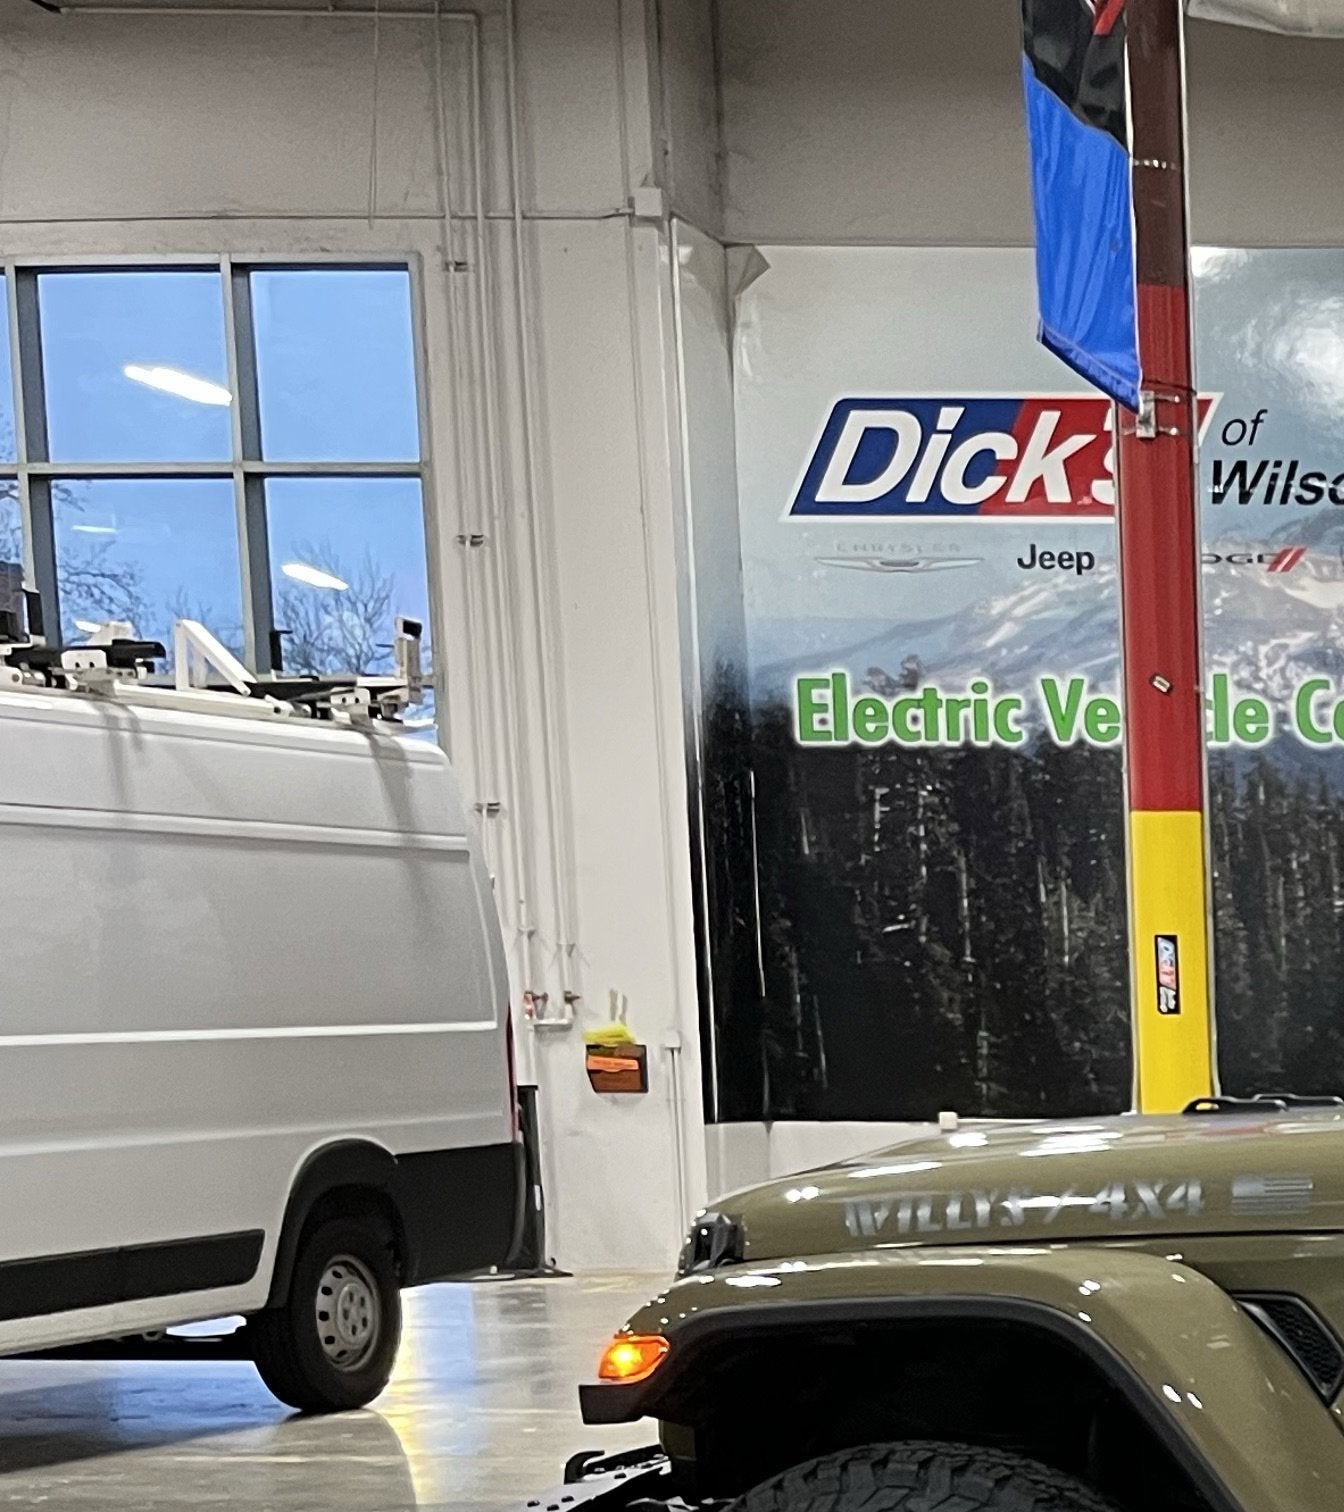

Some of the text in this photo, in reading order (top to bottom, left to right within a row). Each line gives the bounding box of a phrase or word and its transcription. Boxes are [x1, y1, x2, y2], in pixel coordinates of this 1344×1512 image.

[1221, 409, 1268, 446] of
[1017, 544, 1095, 576] Jeep
[799, 673, 1023, 742] Electric
[1042, 674, 1269, 742] Vele
